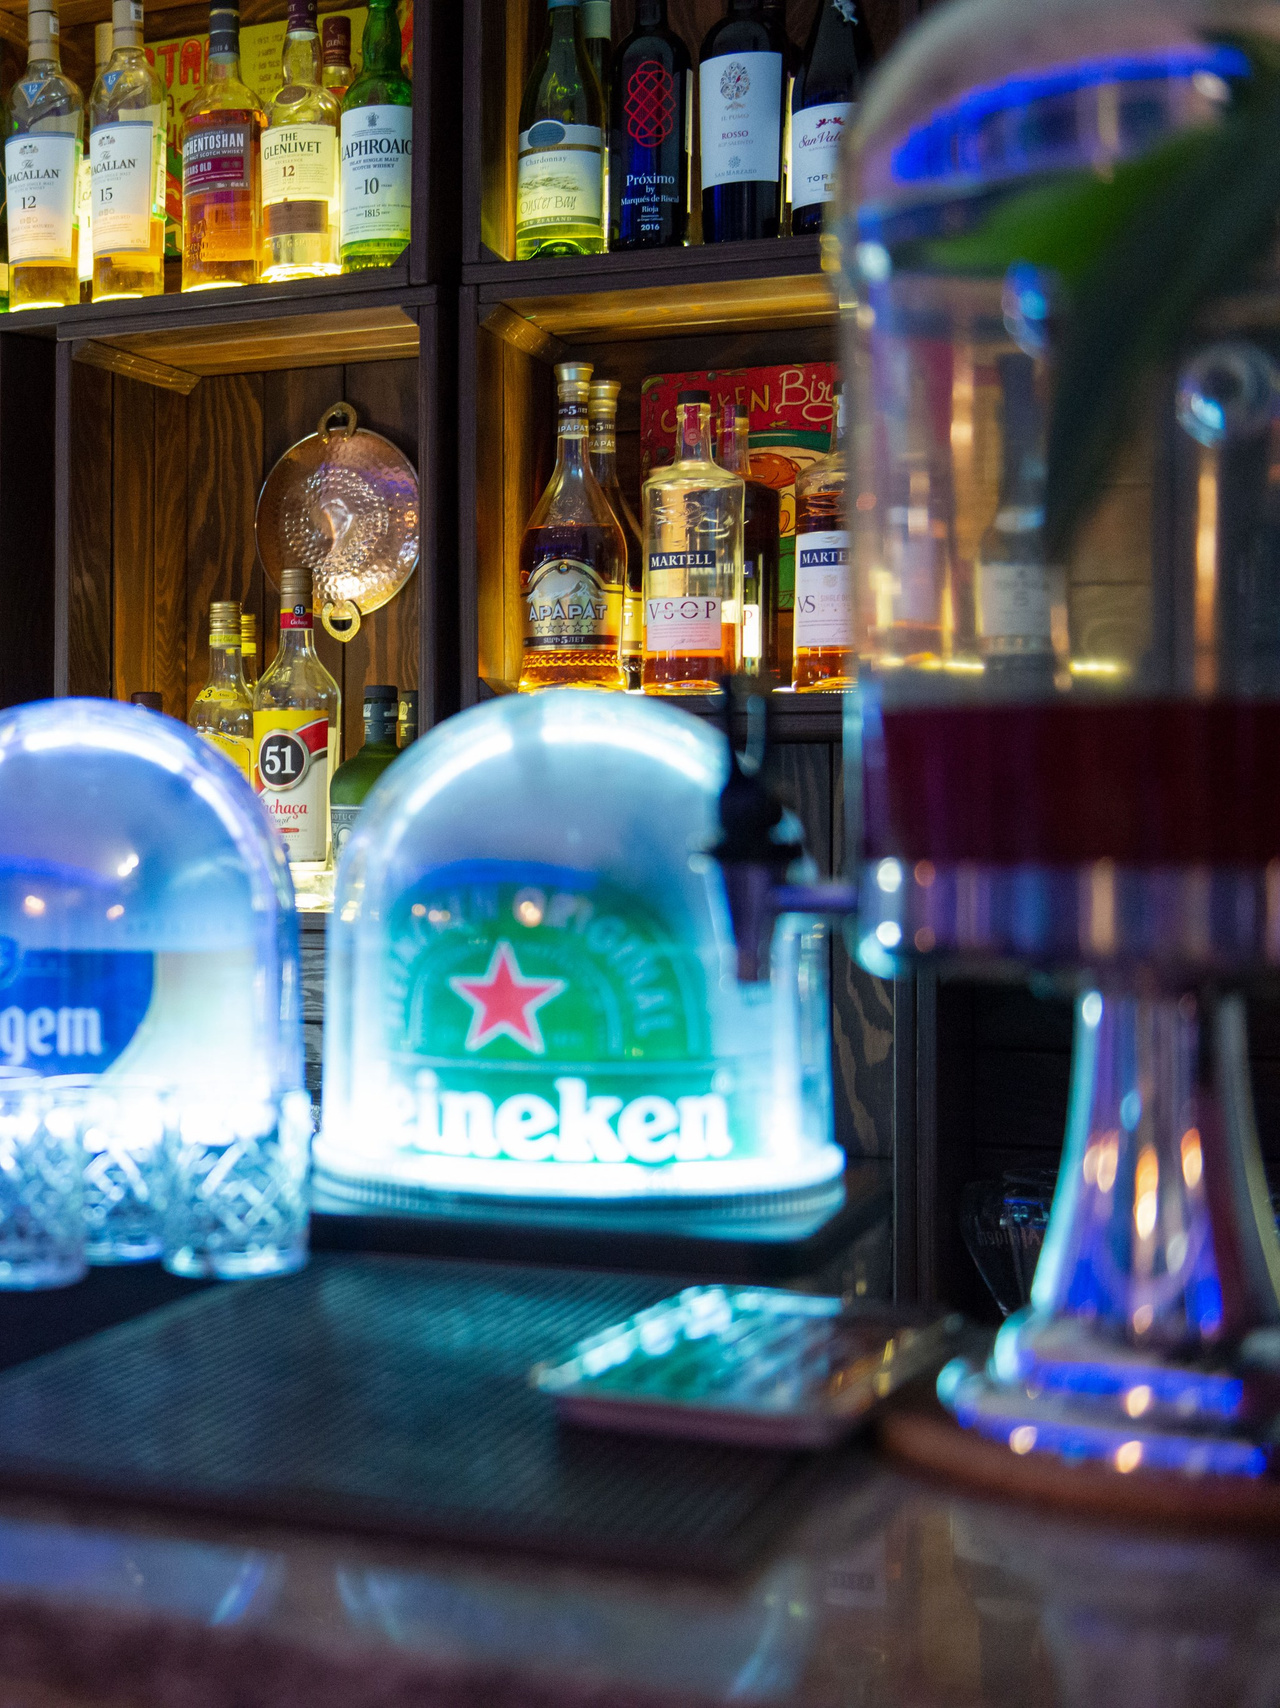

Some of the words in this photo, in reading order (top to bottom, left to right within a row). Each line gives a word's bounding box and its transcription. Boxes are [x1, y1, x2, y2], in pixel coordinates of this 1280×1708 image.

[280, 132, 298, 142] THE
[721, 130, 749, 140] ROSSO
[798, 135, 817, 149] San
[264, 141, 322, 160] GLENLIVET
[525, 156, 567, 167] Chardonnay
[7, 168, 60, 186] MACALLAN
[282, 165, 296, 177] 12
[363, 177, 379, 195] 10
[626, 172, 675, 187] Próximo
[100, 187, 113, 202] 15
[645, 185, 655, 195] by
[21, 195, 37, 210] 12
[520, 196, 553, 215] Oyster
[555, 195, 577, 210] Bay
[650, 194, 660, 203] de
[364, 209, 380, 218] 1815
[642, 205, 659, 214] Rioja
[641, 223, 660, 231] 2016
[651, 553, 713, 568] MARTELL
[294, 605, 304, 615] 51
[649, 601, 717, 620] VSOP
[797, 595, 816, 614] VS
[205, 690, 213, 699] 3
[265, 745, 296, 775] 51
[261, 798, 309, 820] achaça
